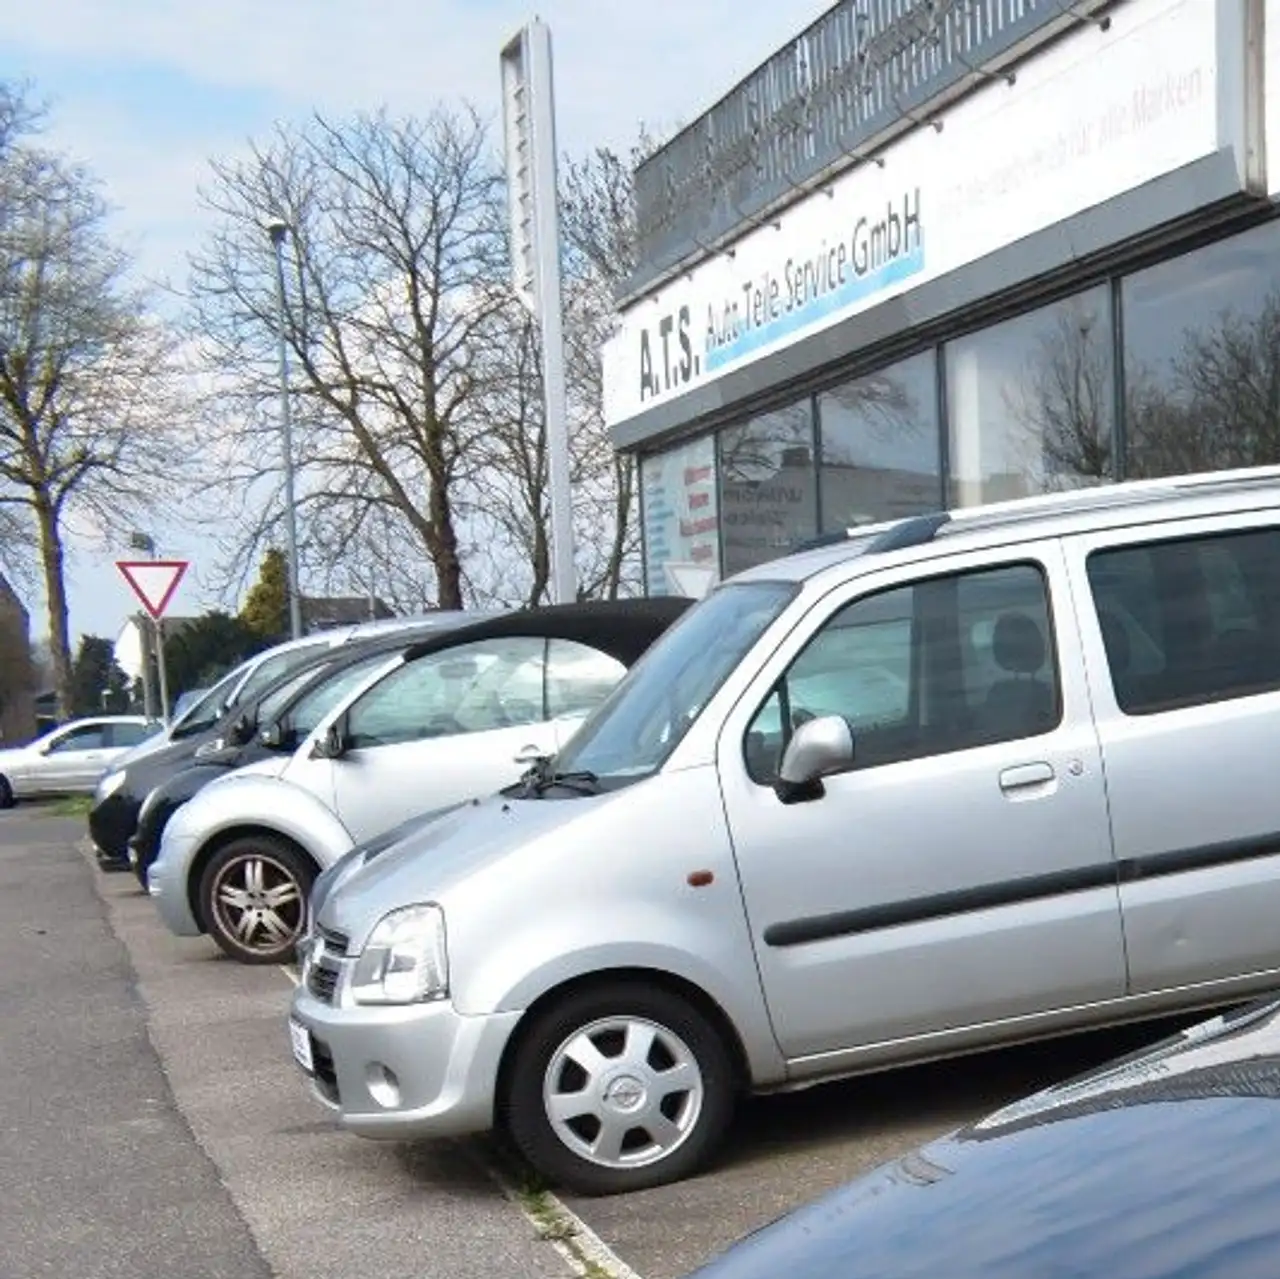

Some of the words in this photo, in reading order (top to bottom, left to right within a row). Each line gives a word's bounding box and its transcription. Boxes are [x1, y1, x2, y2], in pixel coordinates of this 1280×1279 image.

[639, 304, 701, 403] A.T.S.
[742, 274, 780, 332] Teile
[783, 237, 848, 309] Service
[851, 186, 921, 276] GmbH
